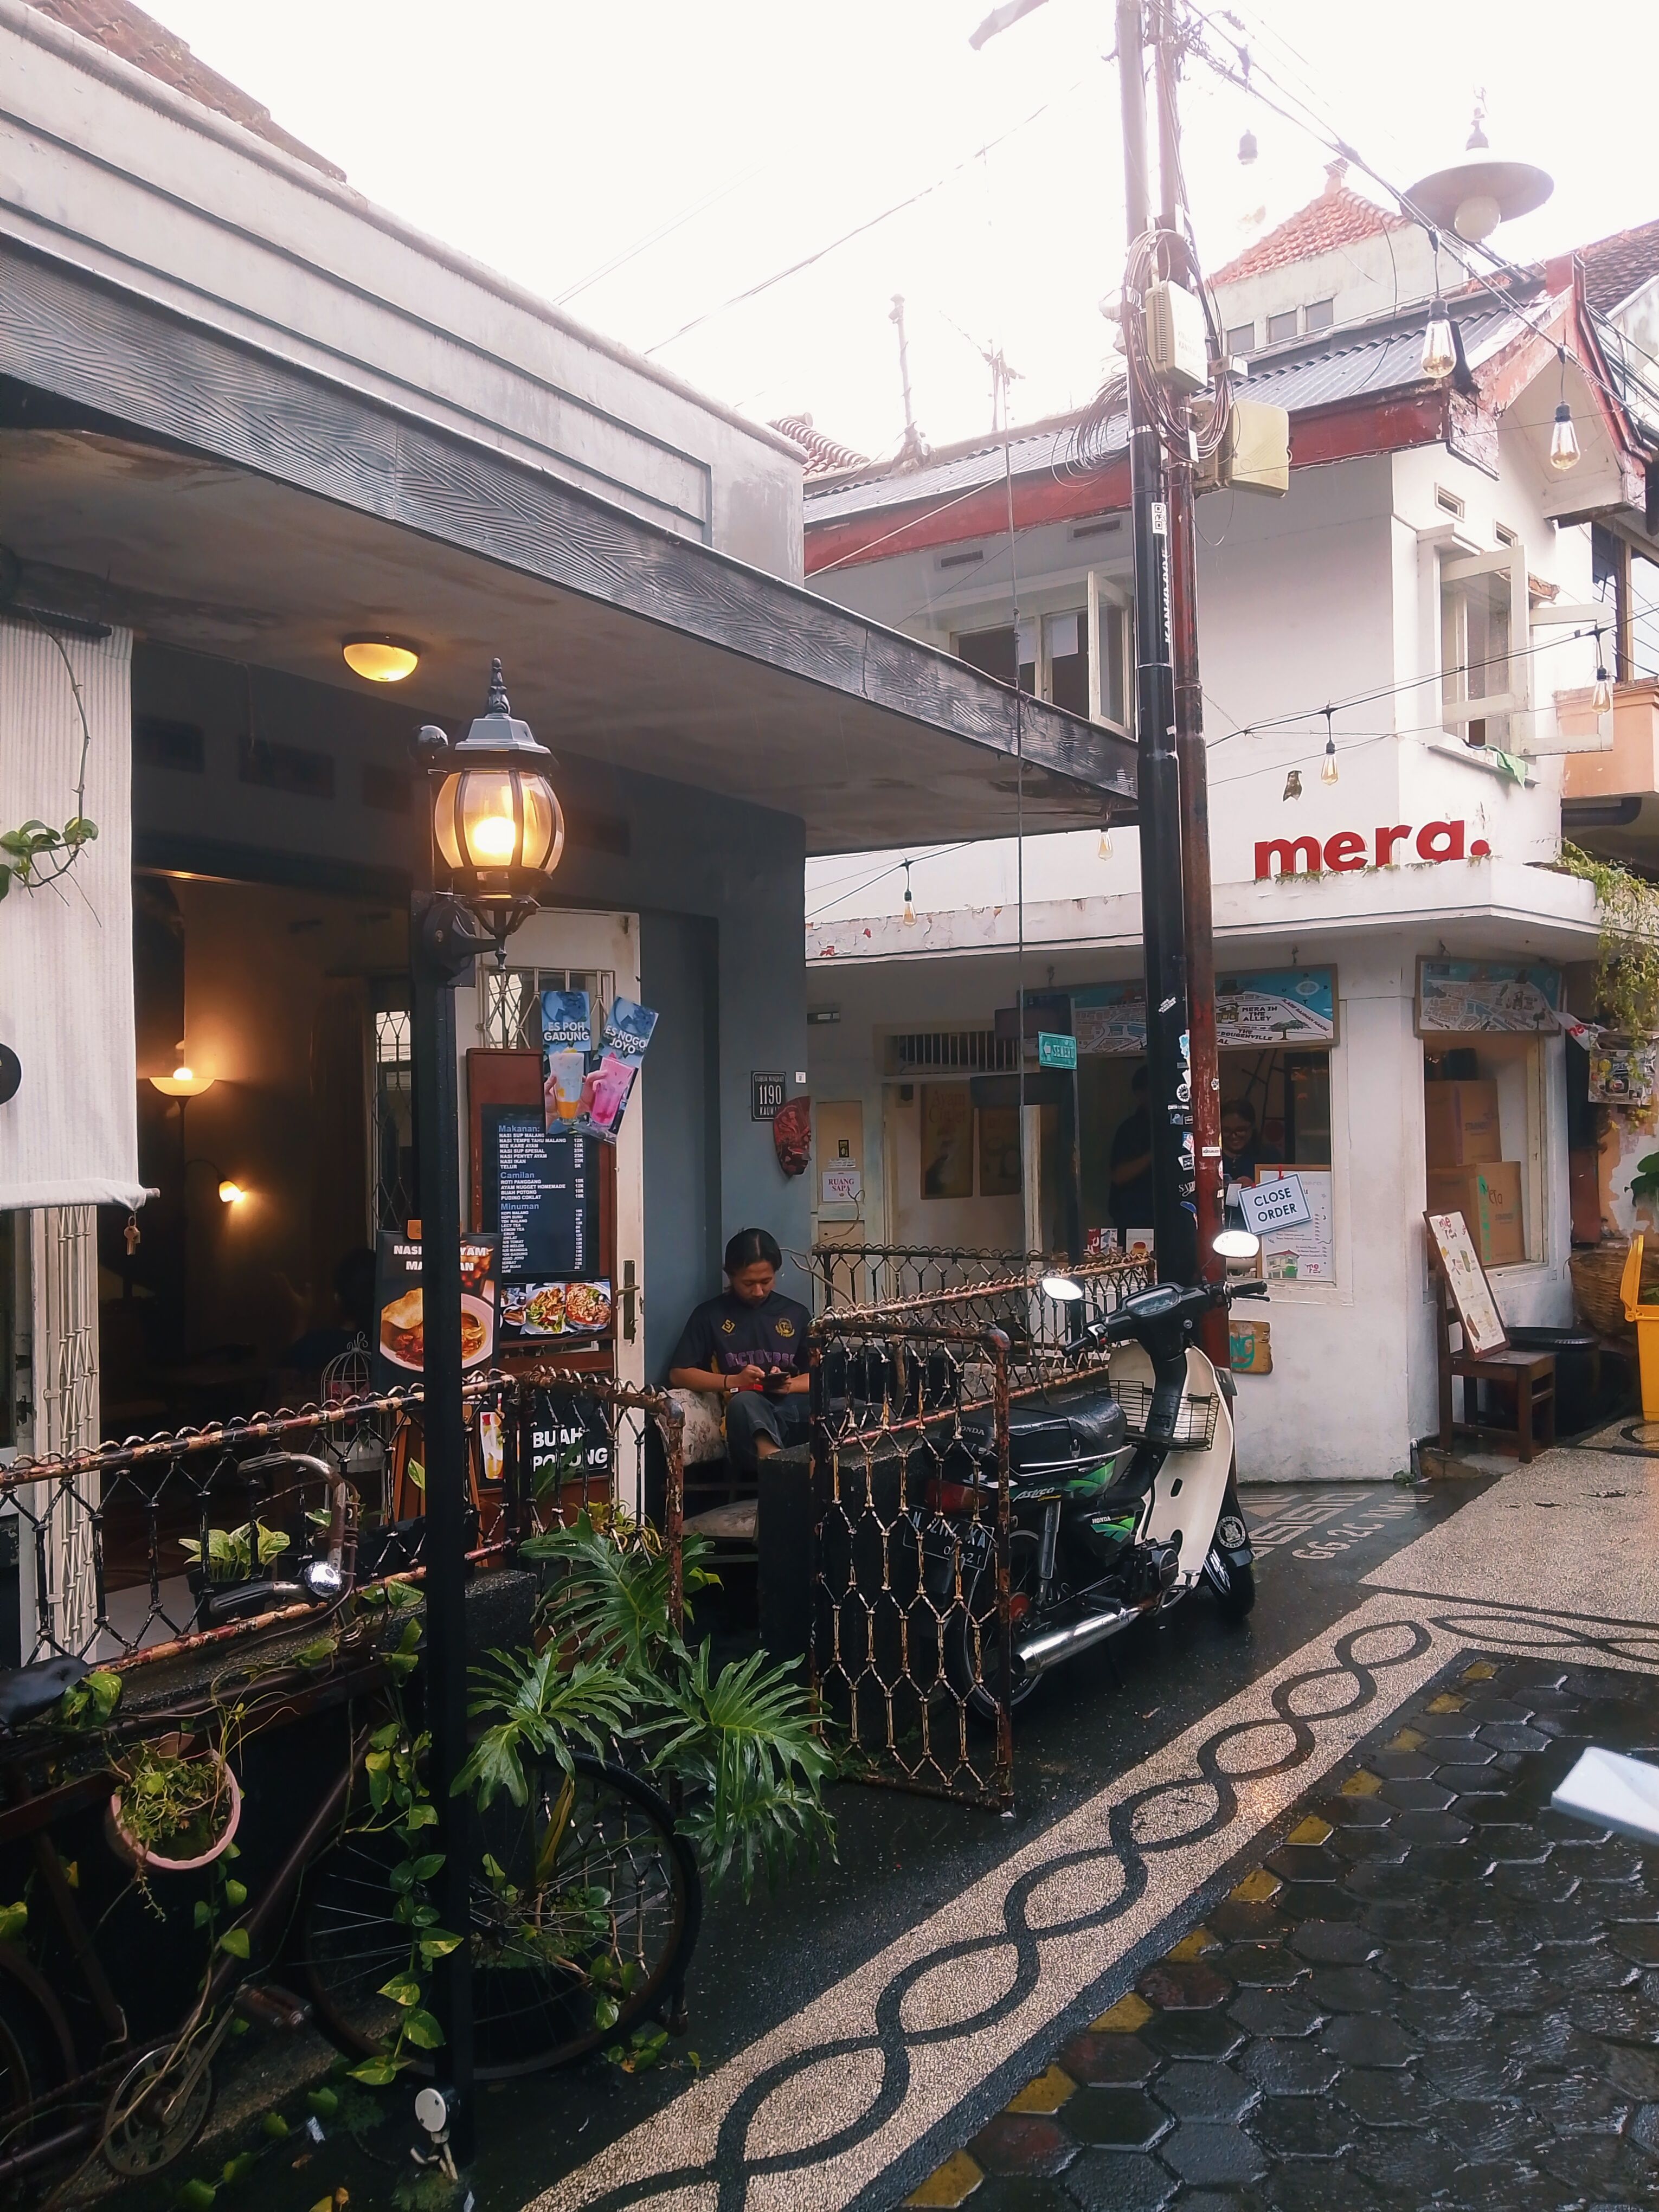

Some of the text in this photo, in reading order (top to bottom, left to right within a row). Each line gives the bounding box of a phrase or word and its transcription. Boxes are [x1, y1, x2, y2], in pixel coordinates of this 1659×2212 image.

[1255, 820, 1490, 880] mera.
[548, 1021, 585, 1031] ES POH
[544, 1032, 590, 1041] GADUNG
[605, 1025, 647, 1049] ES NOGO
[609, 1037, 636, 1054] JOYO
[759, 1084, 781, 1104] 1190
[760, 1107, 781, 1116] KAUM
[1254, 1187, 1292, 1207] CLOSE
[1258, 1203, 1297, 1222] ORDER
[394, 1245, 486, 1256] NASI YAM
[533, 1427, 584, 1448] BUAH
[533, 1448, 608, 1472] POONG
[1092, 1516, 1111, 1524] HONDA
